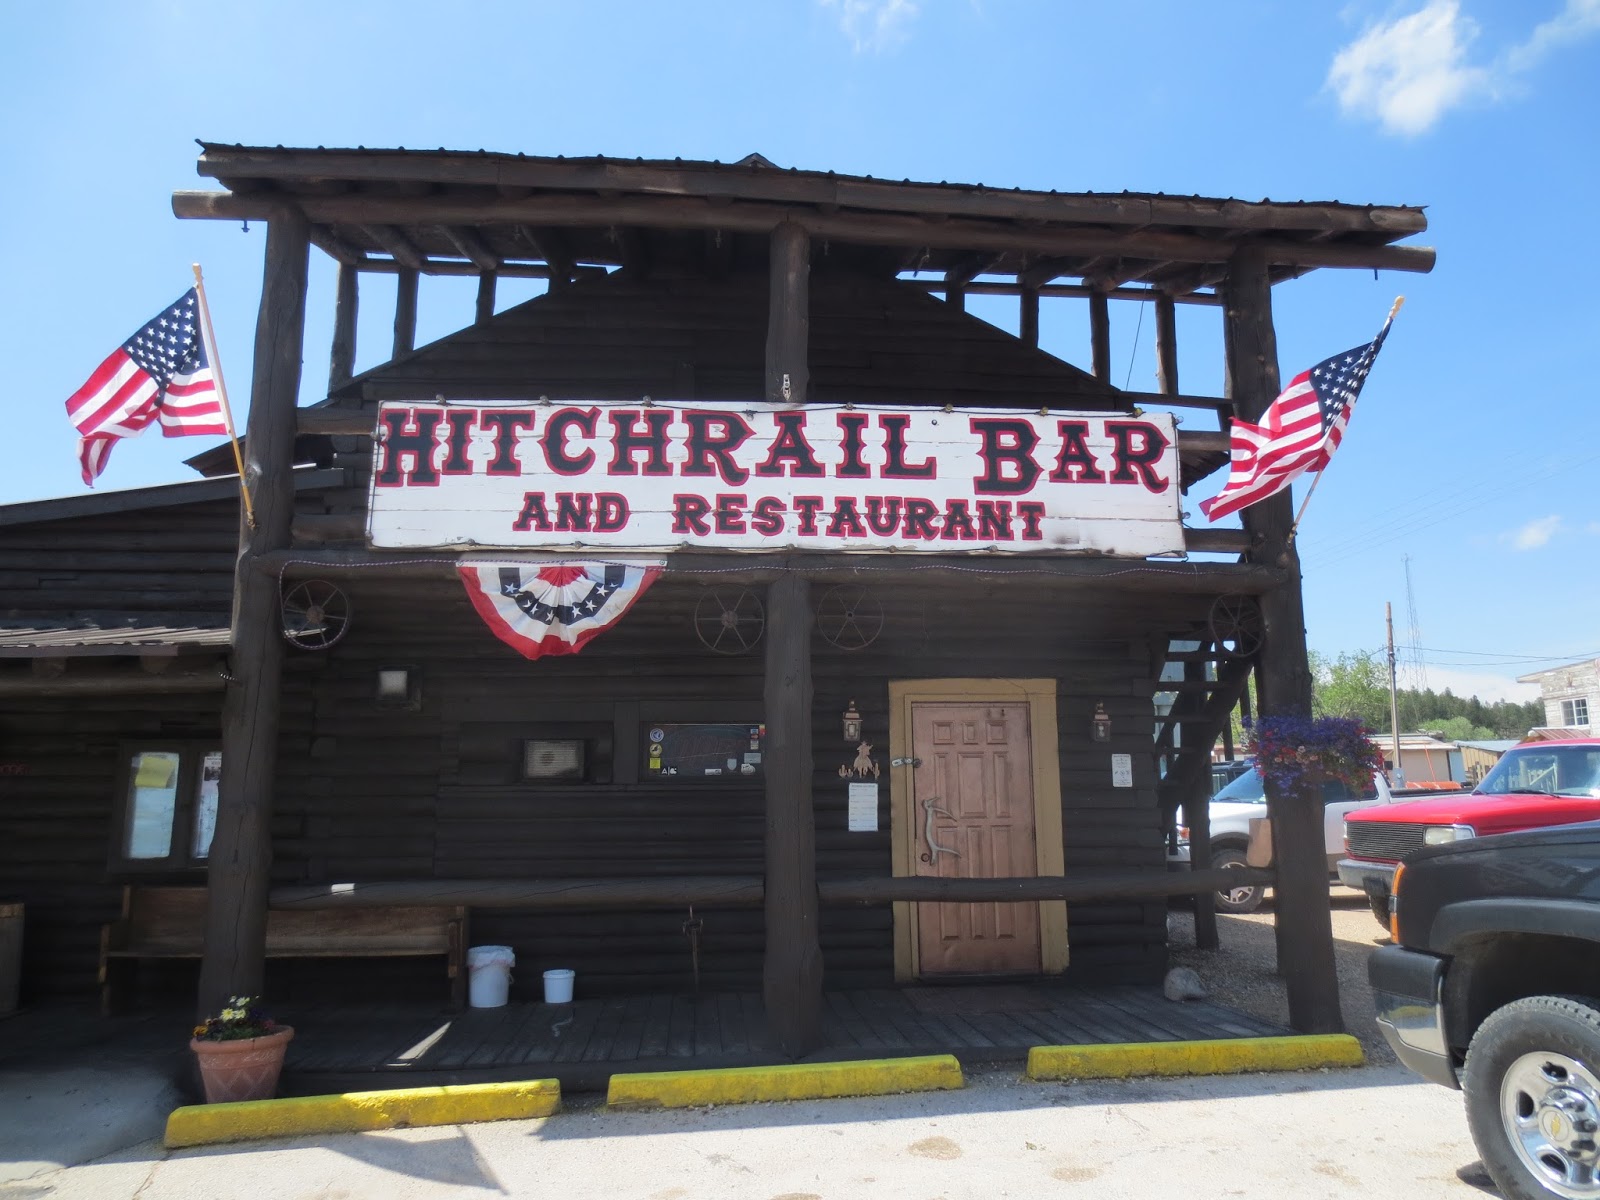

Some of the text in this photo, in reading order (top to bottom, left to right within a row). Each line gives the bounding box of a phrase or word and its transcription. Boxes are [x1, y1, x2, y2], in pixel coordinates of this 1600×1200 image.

[375, 406, 1171, 495] HITCHRAIL BAR
[512, 491, 1046, 541] AND RESTAURANT
